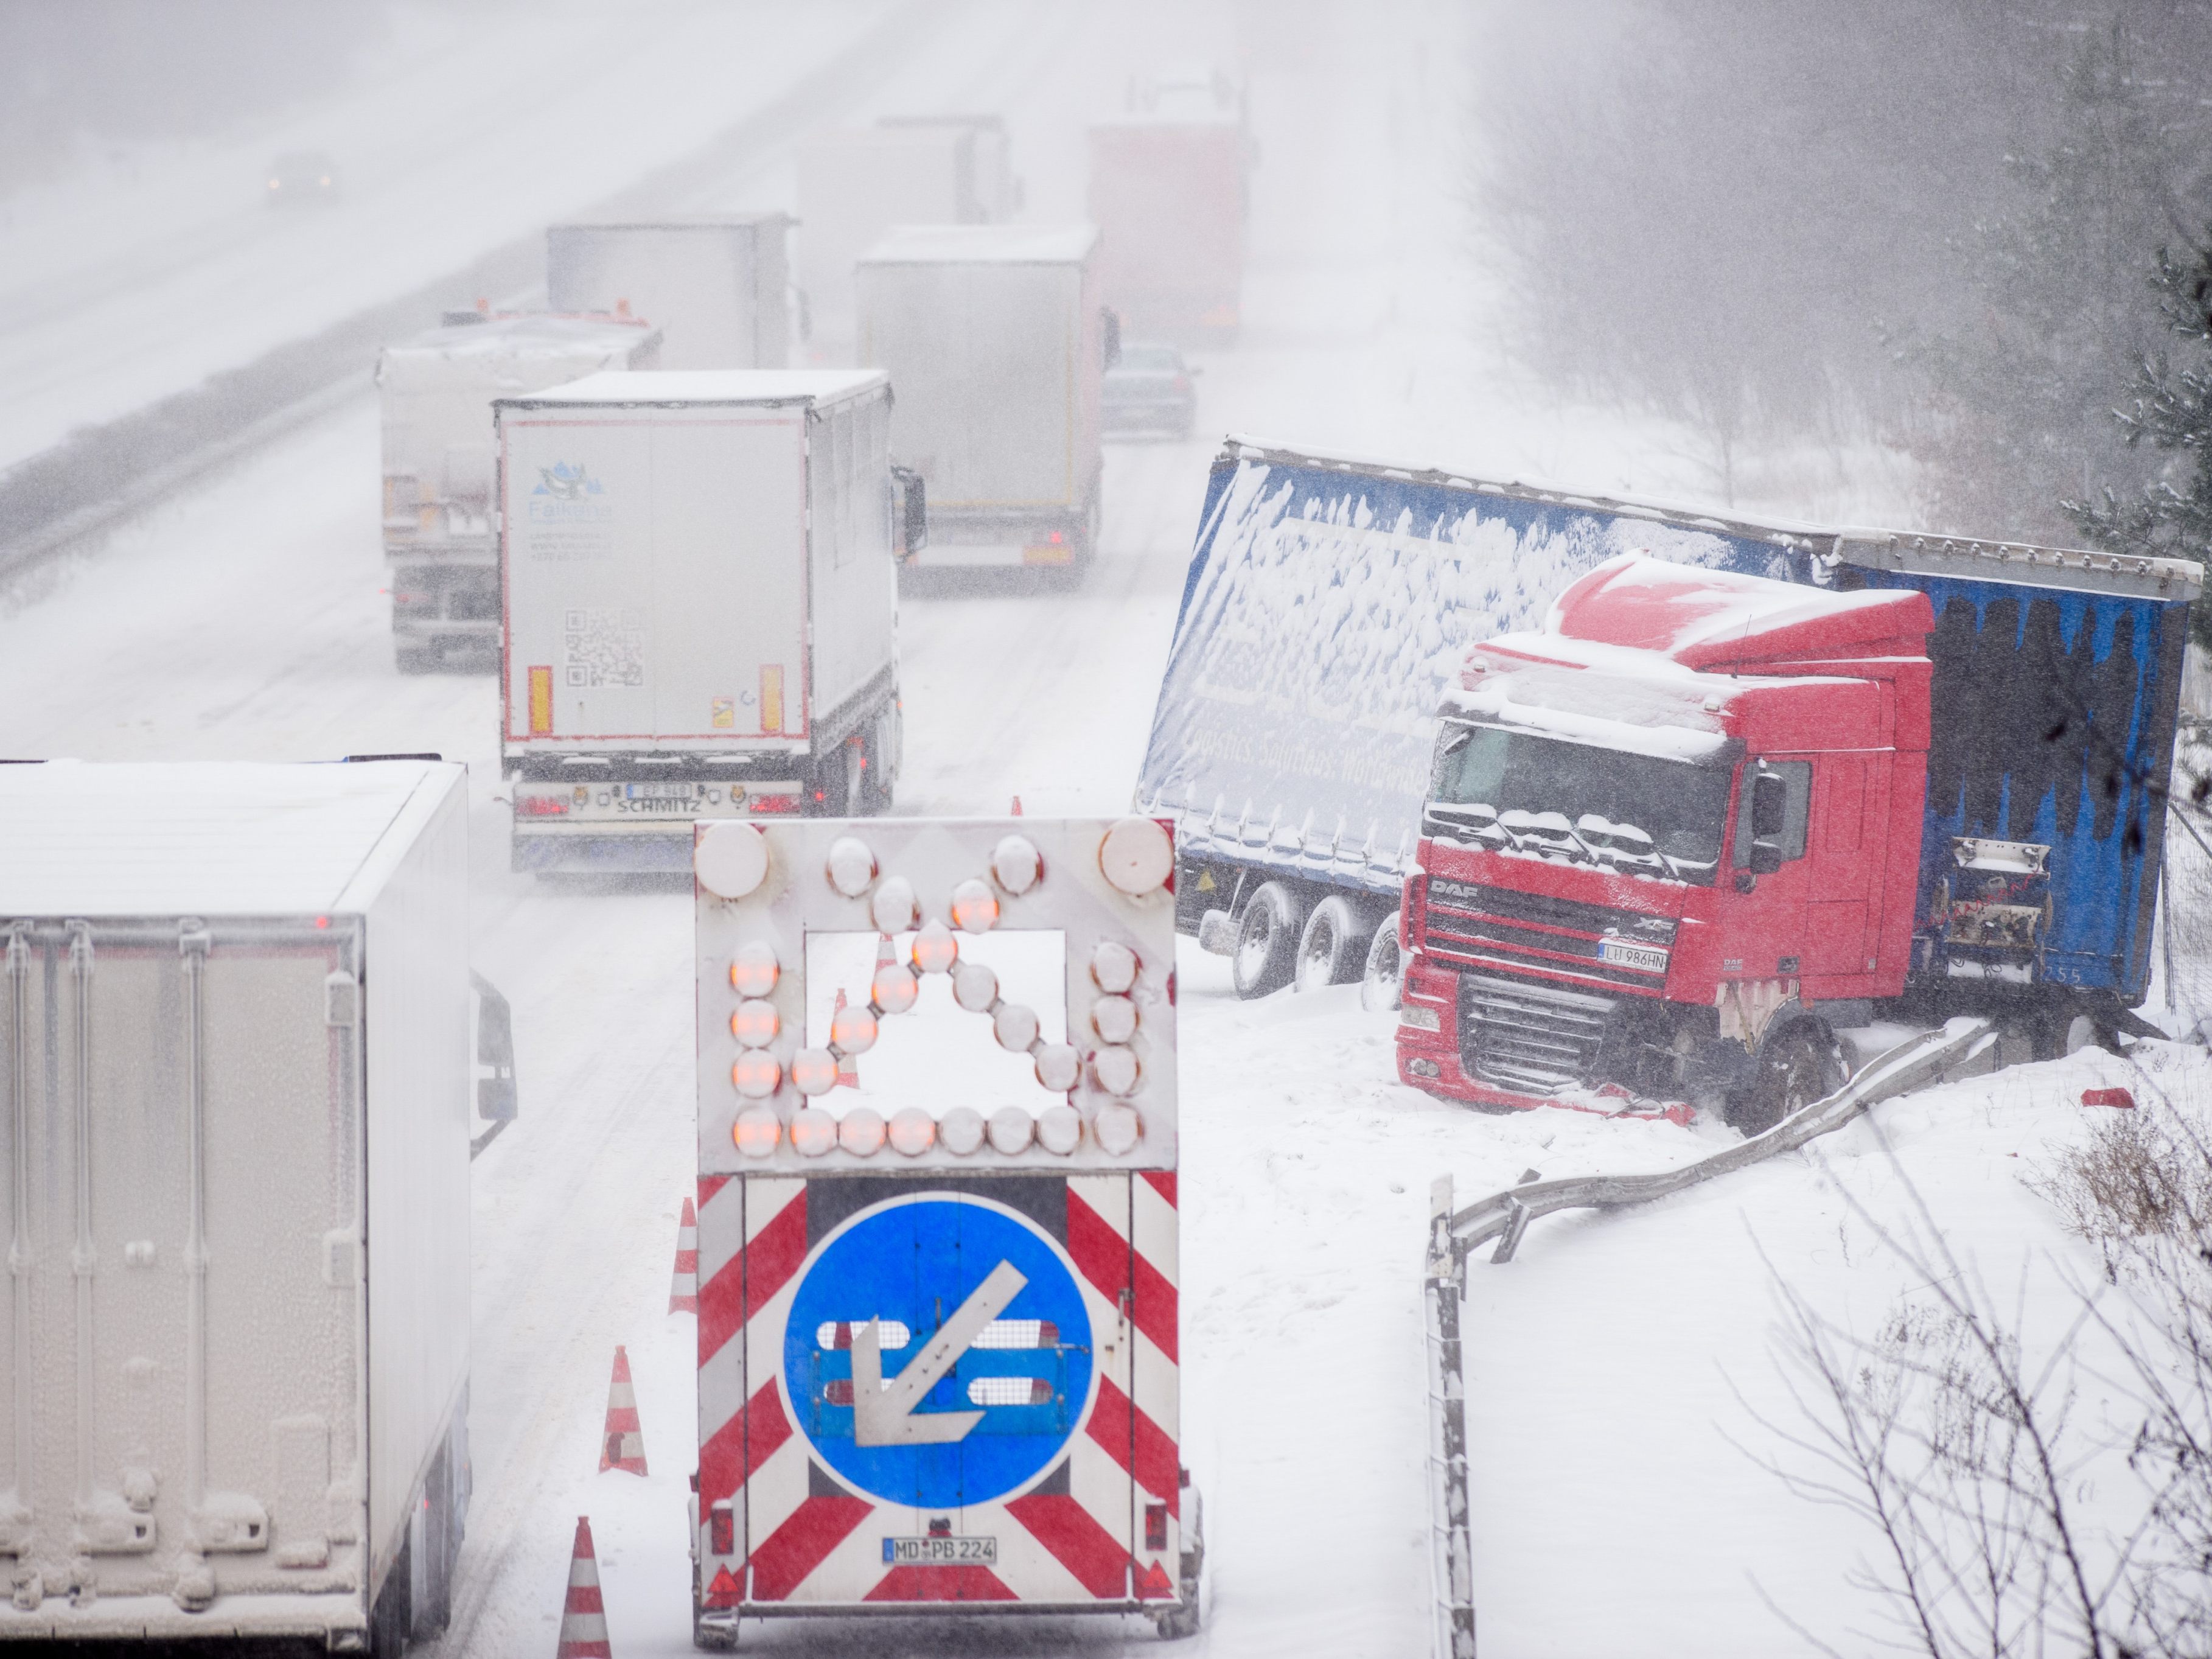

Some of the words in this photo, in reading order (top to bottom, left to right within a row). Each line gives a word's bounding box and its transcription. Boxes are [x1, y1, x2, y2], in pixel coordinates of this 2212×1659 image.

[617, 798, 701, 812] SCHMITZ
[1430, 880, 1478, 898] DAF
[1607, 946, 1622, 961] LU
[1626, 950, 1664, 969] 986HN
[895, 1541, 918, 1559] MD
[932, 1541, 955, 1559] PB
[960, 1541, 993, 1559] 224
